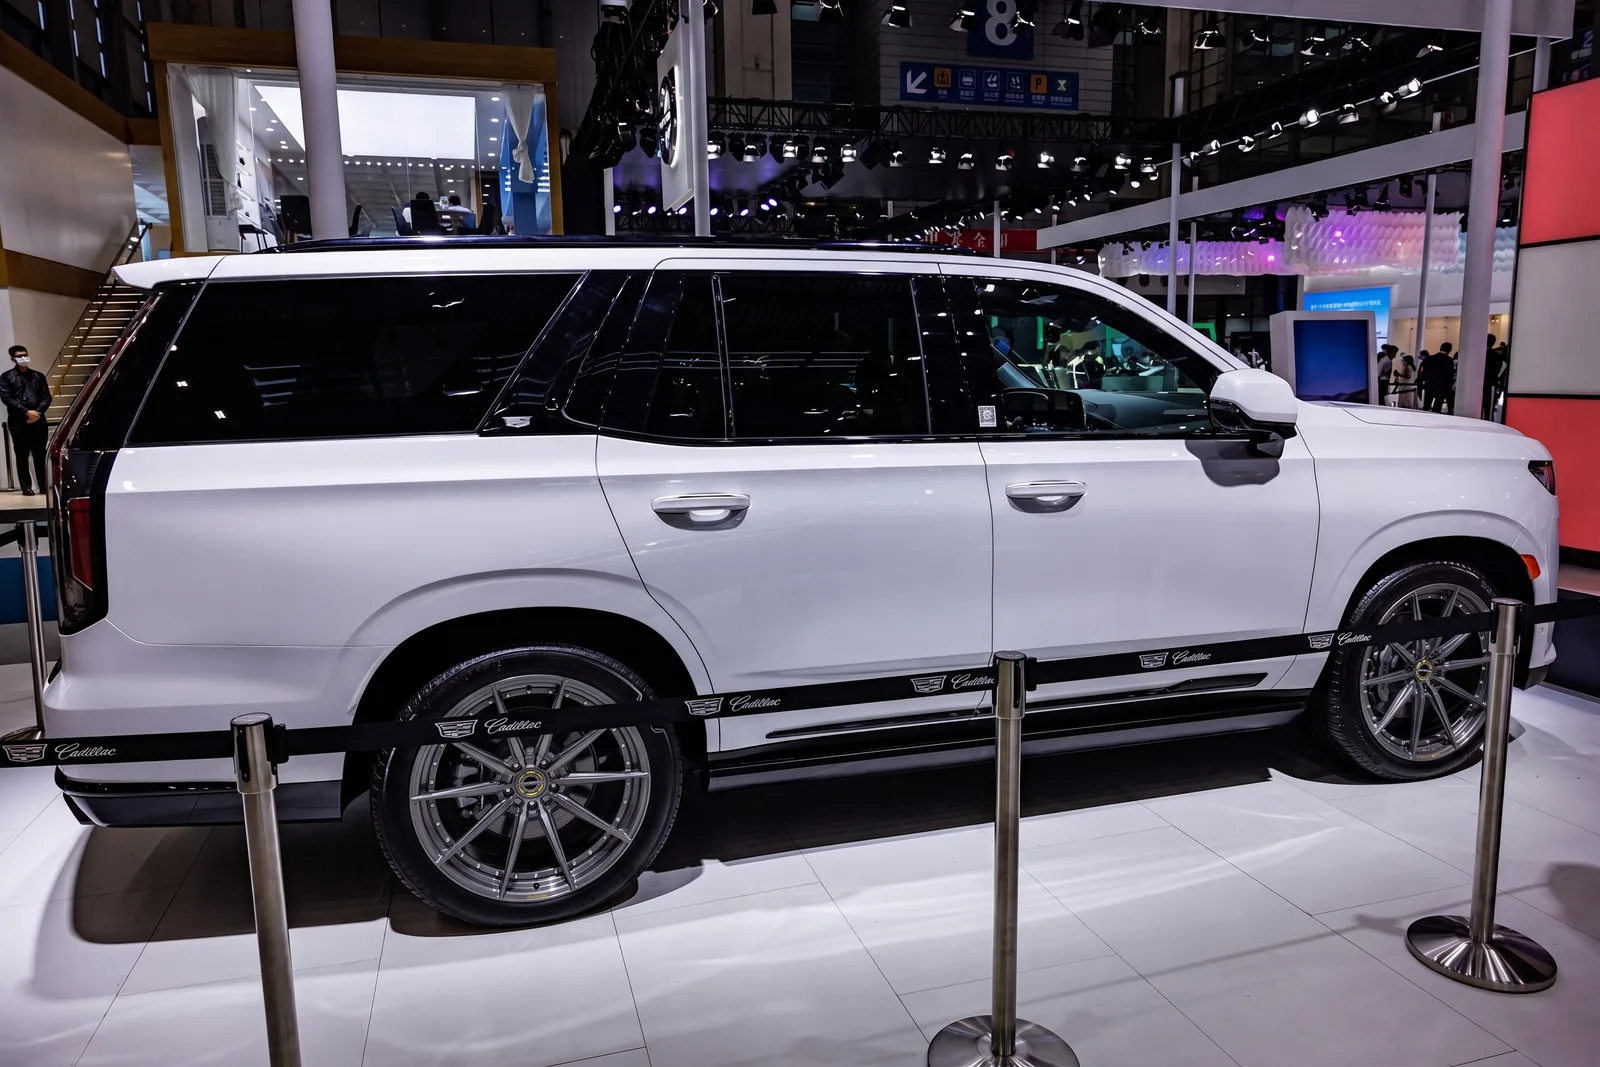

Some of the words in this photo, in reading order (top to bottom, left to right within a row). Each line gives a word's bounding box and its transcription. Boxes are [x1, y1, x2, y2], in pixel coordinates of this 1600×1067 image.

[985, 0, 1017, 46] 8
[1035, 77, 1042, 91] P
[1337, 632, 1372, 646] Cadillac
[1172, 650, 1212, 666] Cadillac
[729, 694, 781, 712] Cadillac
[484, 717, 542, 735] Cadillac
[54, 742, 116, 760] Cadillac
